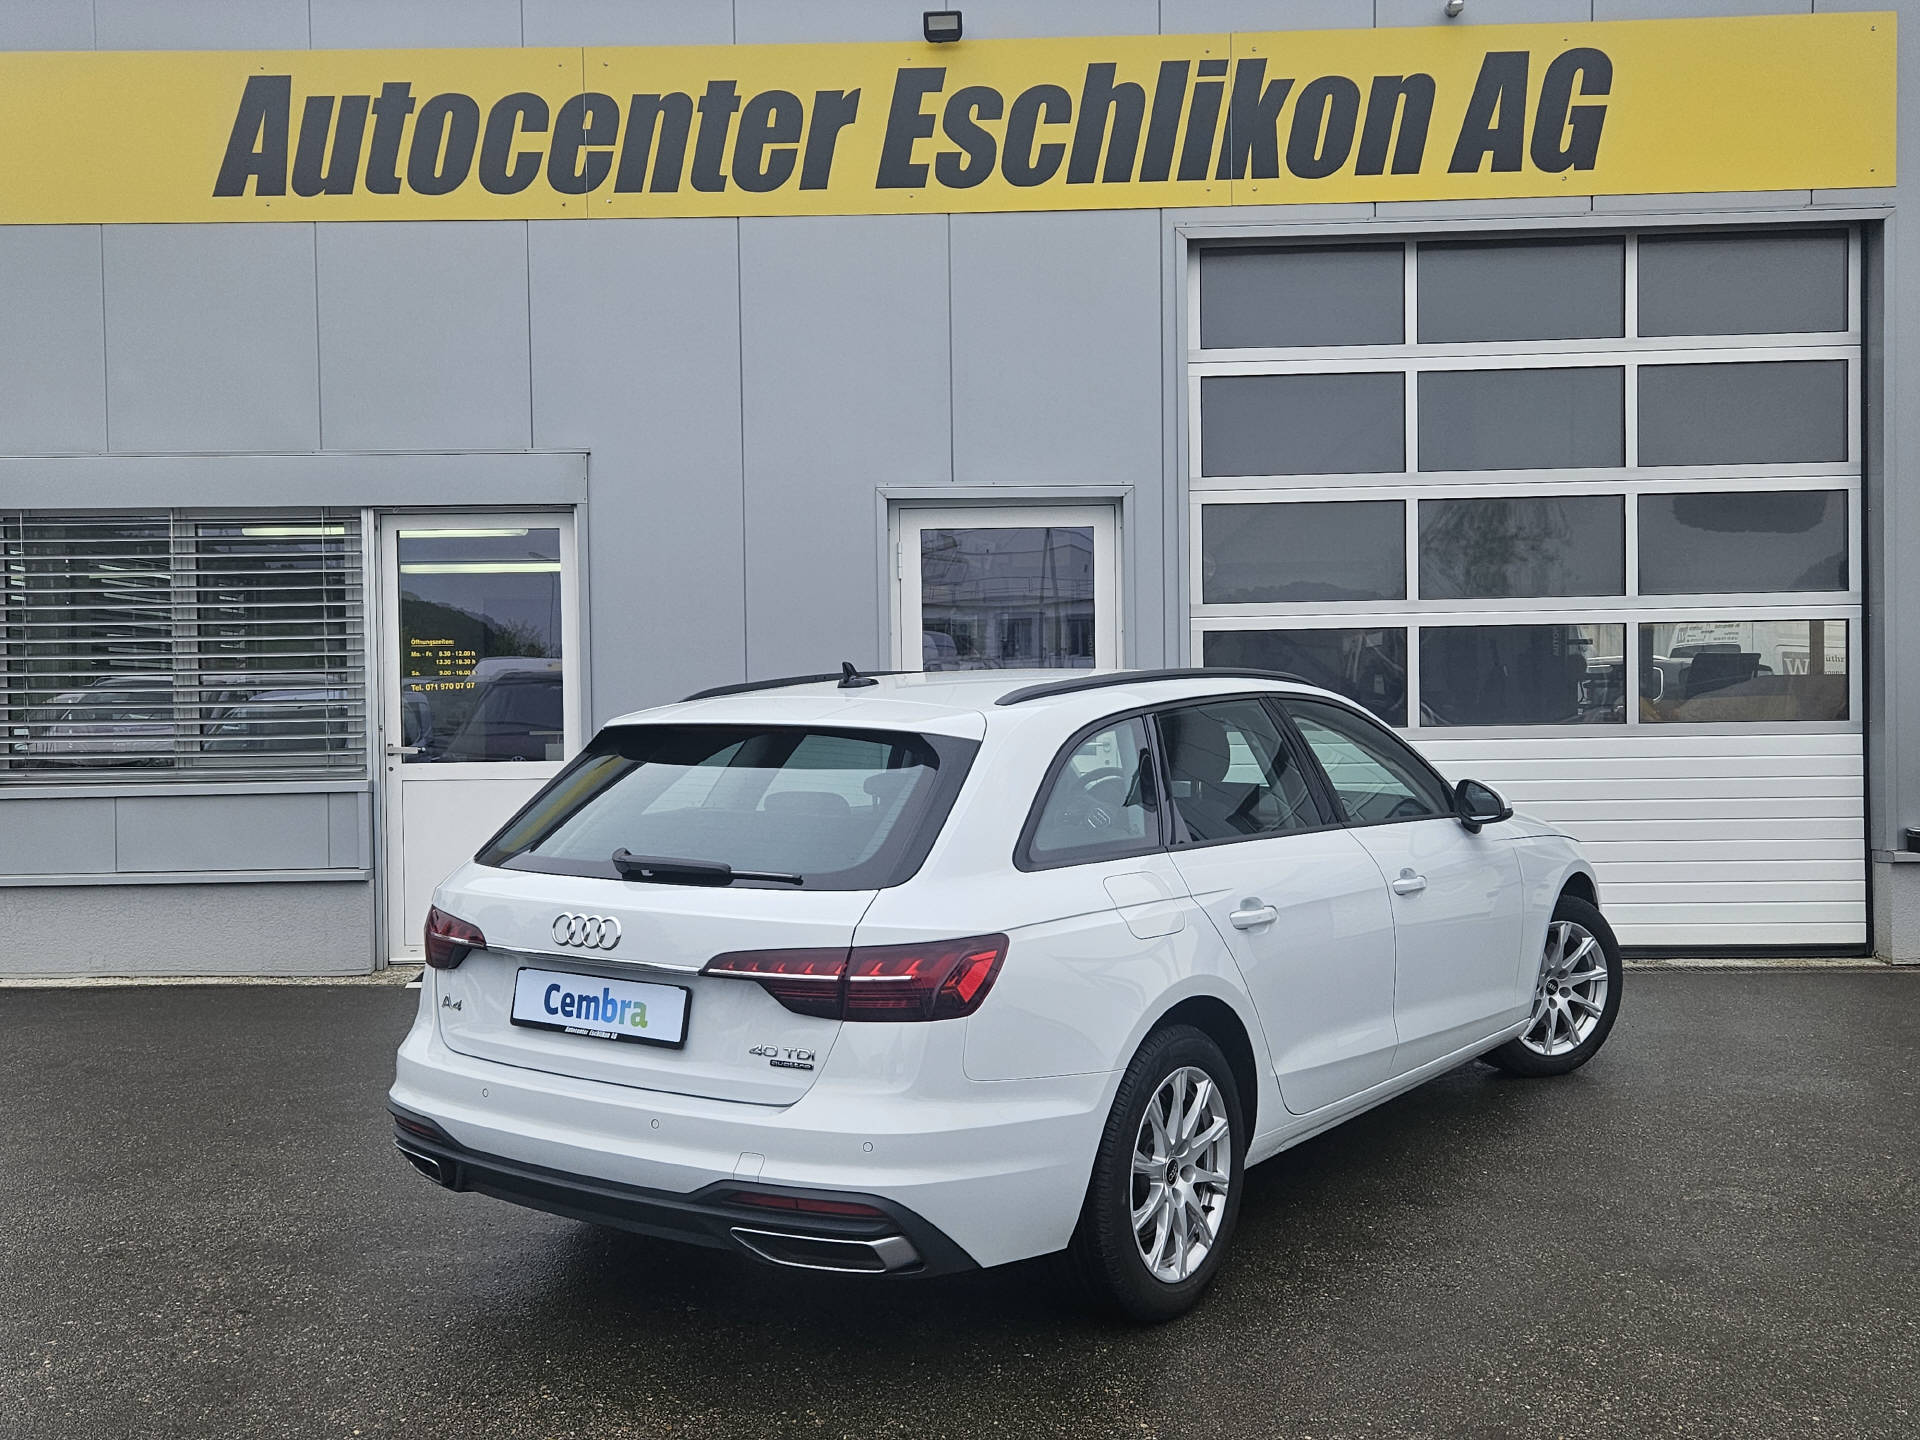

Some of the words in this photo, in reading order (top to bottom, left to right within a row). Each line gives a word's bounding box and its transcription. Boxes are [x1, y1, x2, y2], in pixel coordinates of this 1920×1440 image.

[212, 75, 861, 197] Autocenter
[875, 57, 1436, 189] Eschlikon
[1448, 46, 1613, 174] AG
[410, 684, 424, 692] Tel.
[425, 683, 438, 691] 071
[440, 682, 454, 690] 970
[441, 993, 463, 1011] A4
[543, 983, 648, 1029] Cembra
[748, 1044, 778, 1057] 40
[783, 1047, 815, 1061] TDI
